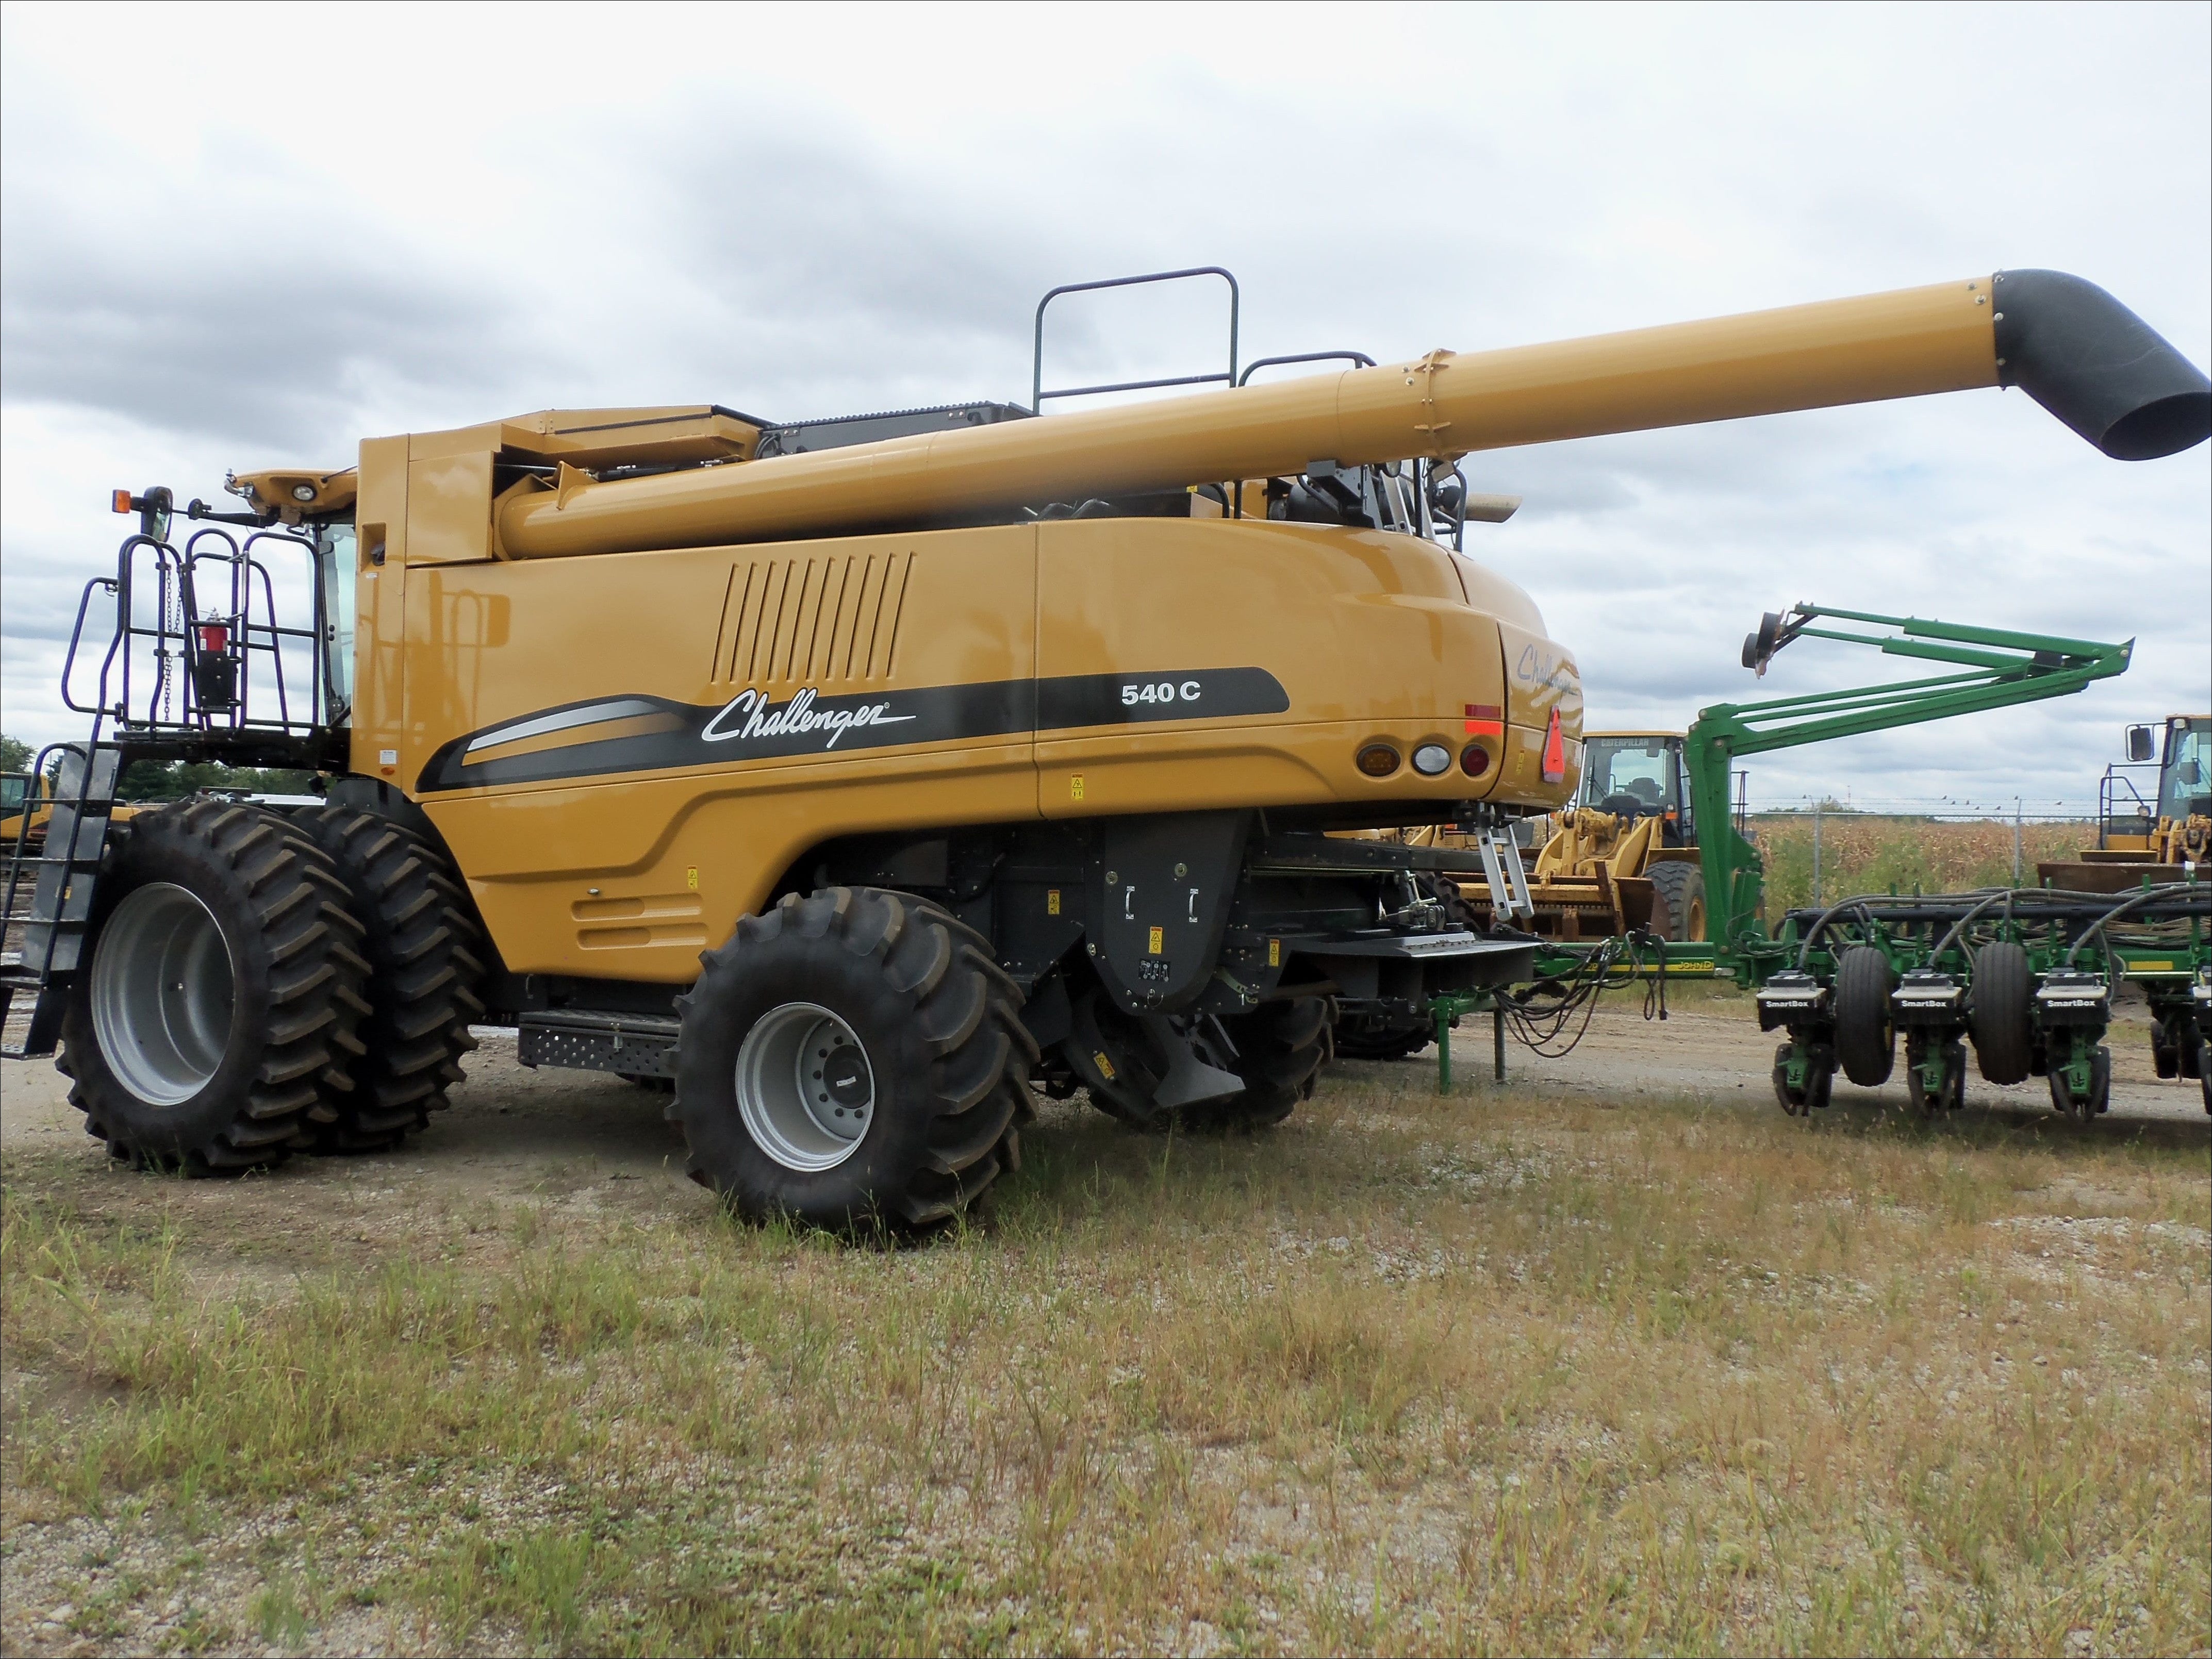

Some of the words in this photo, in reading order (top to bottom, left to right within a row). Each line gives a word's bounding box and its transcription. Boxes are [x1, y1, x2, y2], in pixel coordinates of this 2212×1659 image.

[1121, 683, 1175, 705] 540
[1180, 681, 1201, 701] C
[701, 688, 917, 749] Challenger
[1601, 738, 1649, 746] CATERPILLAR
